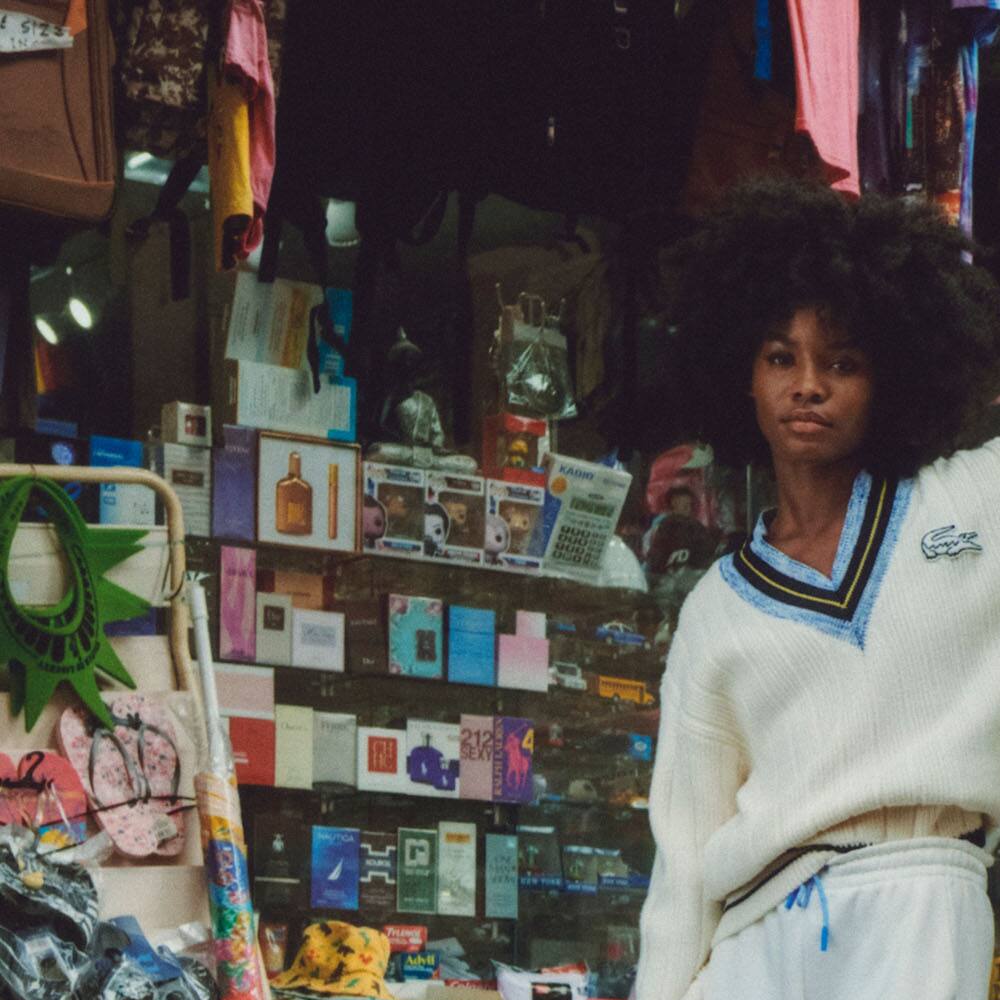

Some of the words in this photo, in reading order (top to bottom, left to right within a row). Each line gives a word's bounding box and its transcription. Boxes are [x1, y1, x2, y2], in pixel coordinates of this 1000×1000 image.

[558, 463, 595, 481] KADIO
[461, 729, 493, 745] 212
[521, 728, 535, 754] 4
[461, 751, 492, 762] SEXY
[494, 761, 503, 797] RALPH
[318, 832, 354, 842] NAUTICA
[407, 954, 436, 967] Advil
